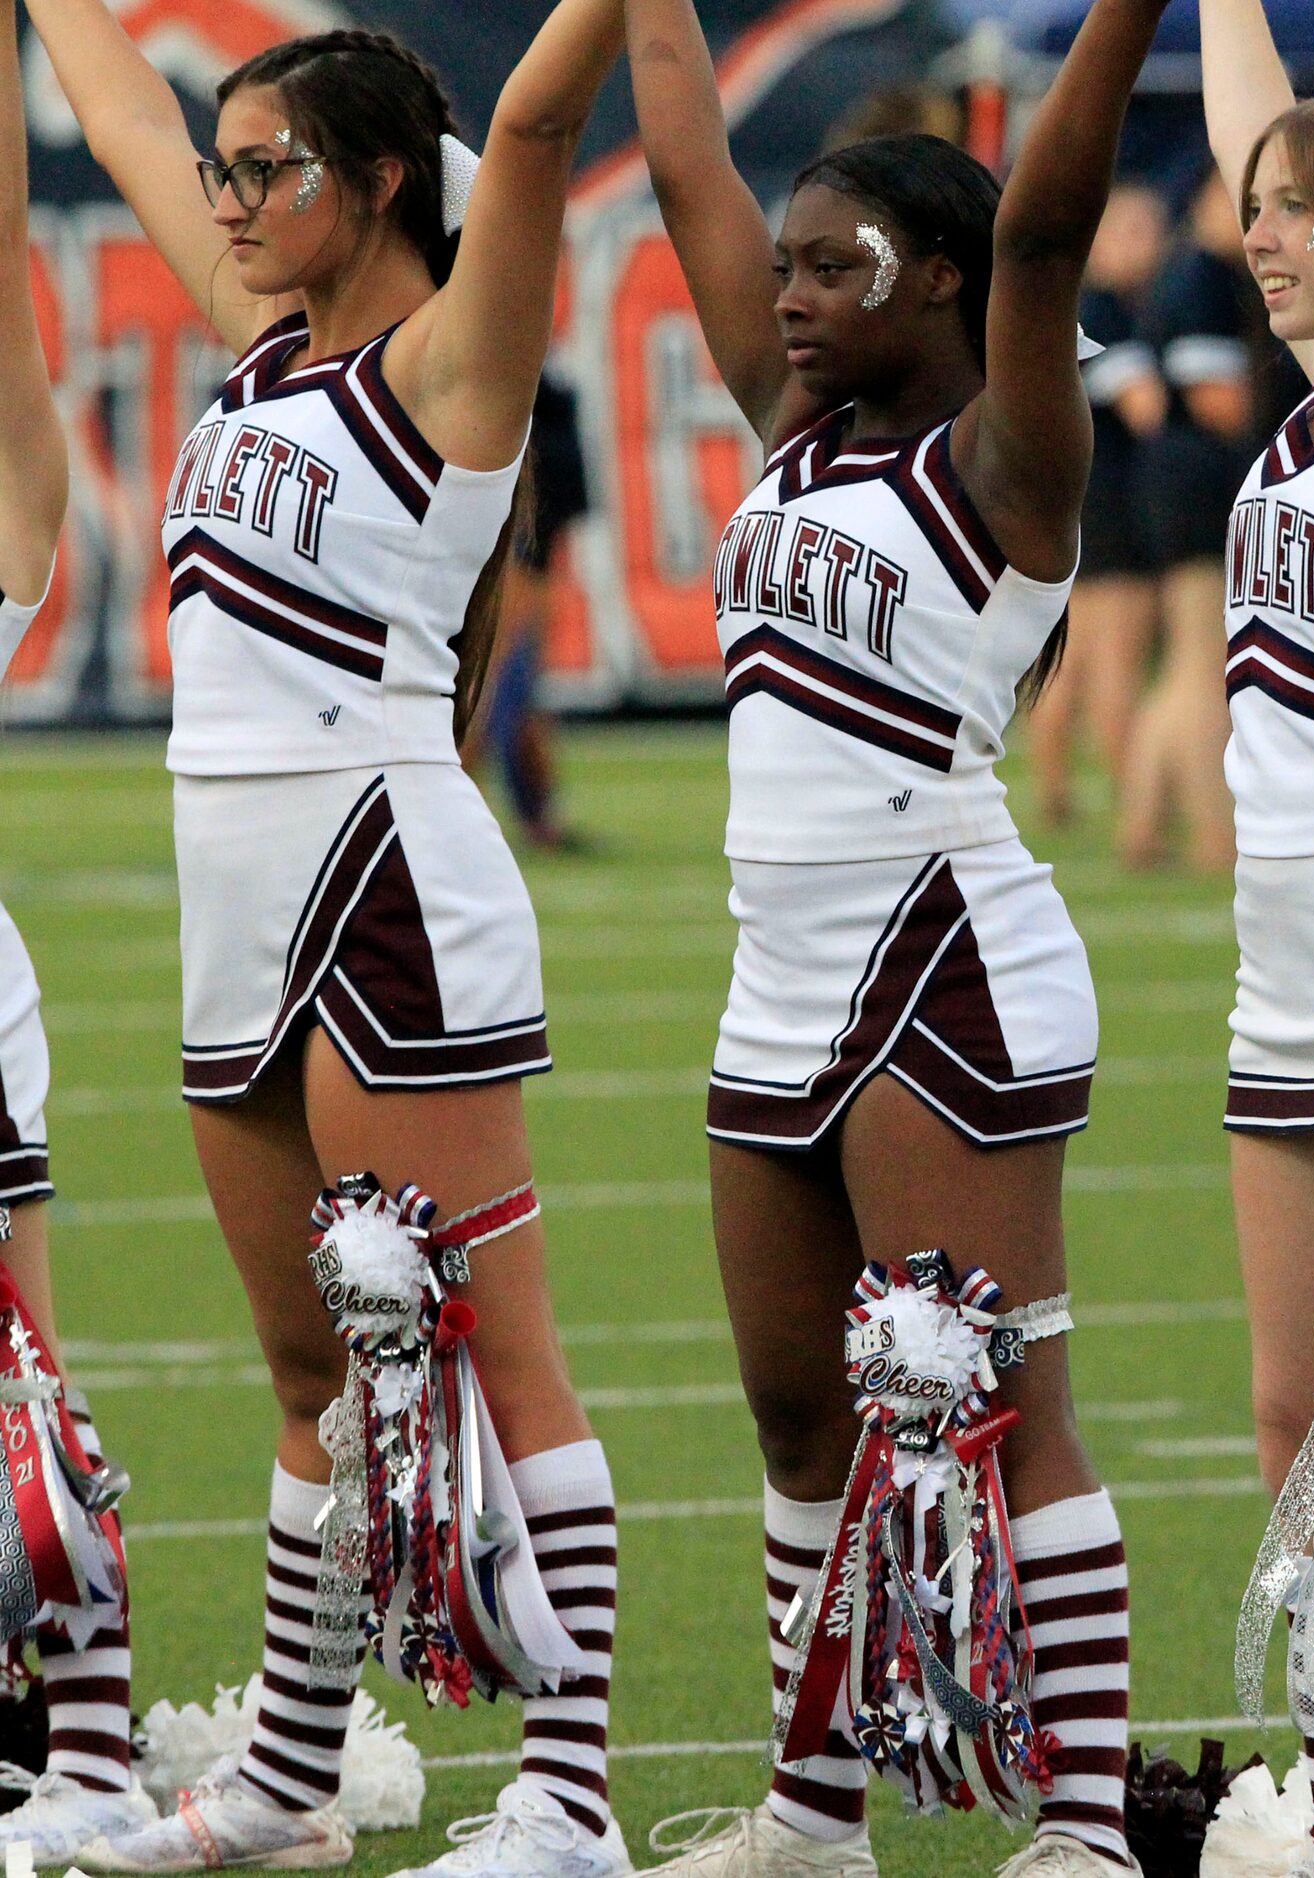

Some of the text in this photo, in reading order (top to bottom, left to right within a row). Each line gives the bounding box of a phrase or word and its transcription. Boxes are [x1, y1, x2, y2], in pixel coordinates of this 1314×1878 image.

[160, 420, 339, 565] WLETT
[320, 1277, 411, 1316] Cheer
[860, 1356, 955, 1398] Cheer
[15, 1456, 35, 1488] 21
